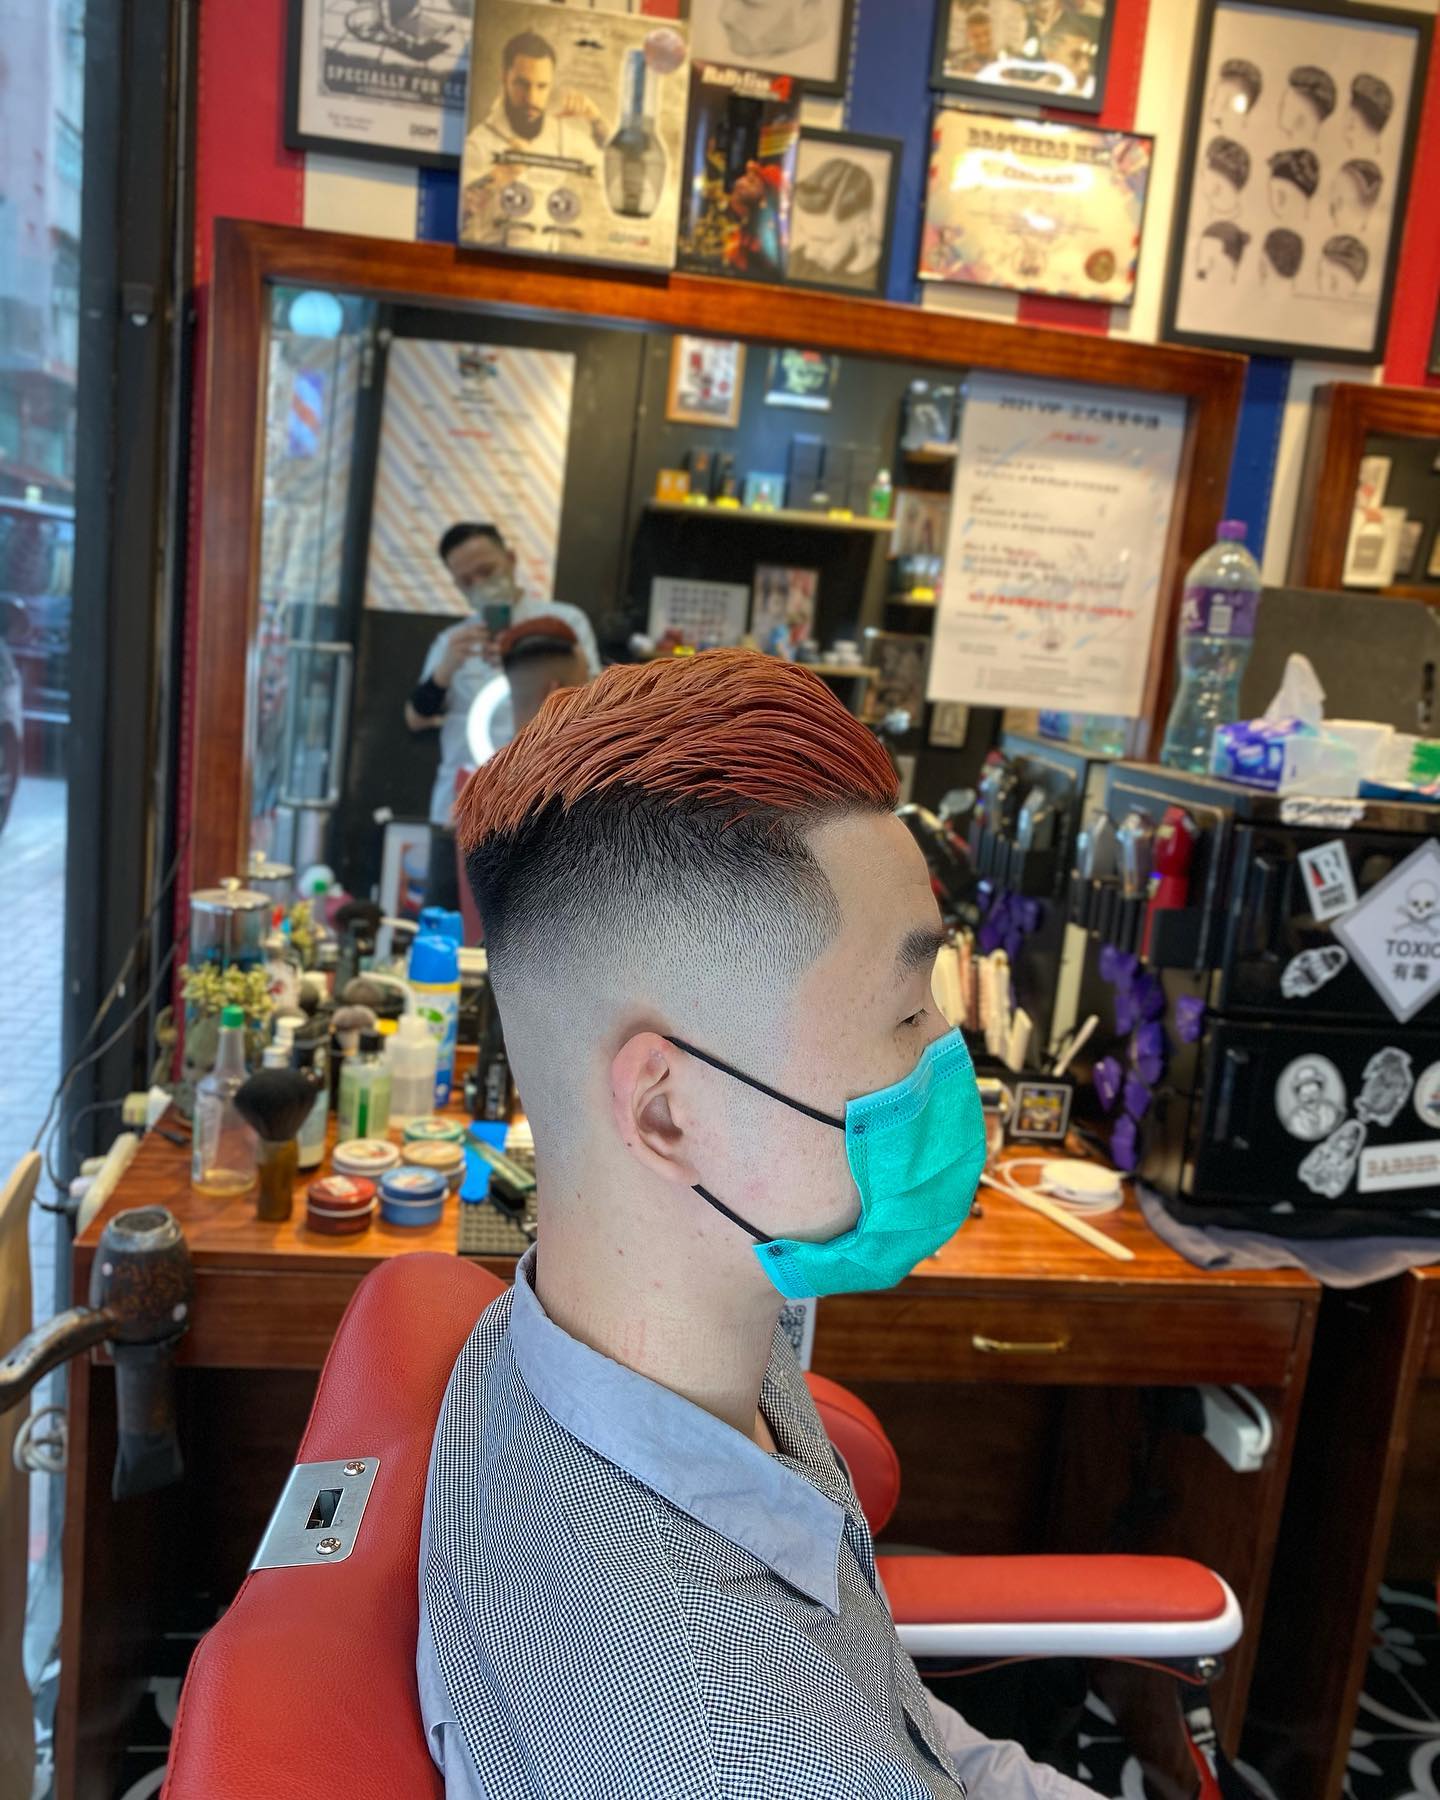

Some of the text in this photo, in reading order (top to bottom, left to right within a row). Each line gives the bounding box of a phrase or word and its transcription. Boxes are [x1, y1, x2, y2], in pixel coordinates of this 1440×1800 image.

[326, 64, 407, 89] SPECIALLY
[411, 76, 441, 95] FOR
[967, 127, 1070, 161] BROTHERS
[1386, 939, 1440, 959] TOXIC
